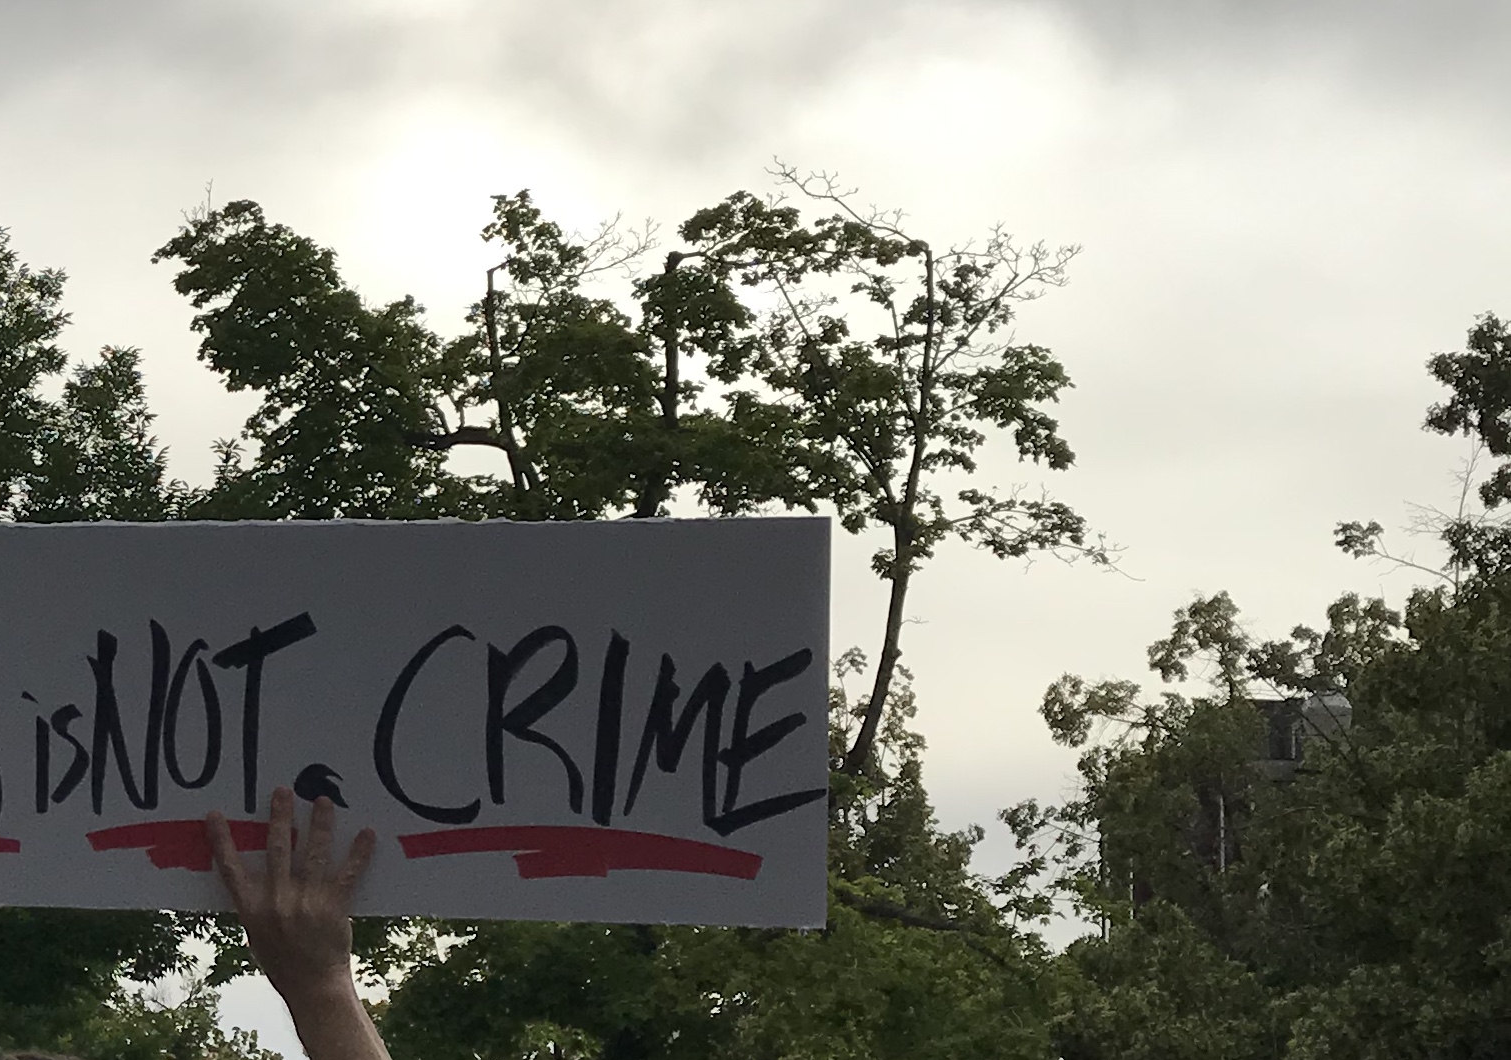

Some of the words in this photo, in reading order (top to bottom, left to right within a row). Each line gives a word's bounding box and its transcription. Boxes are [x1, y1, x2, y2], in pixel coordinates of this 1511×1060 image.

[21, 690, 86, 814] is
[88, 611, 317, 814] NOT
[373, 623, 827, 835] CRIME
